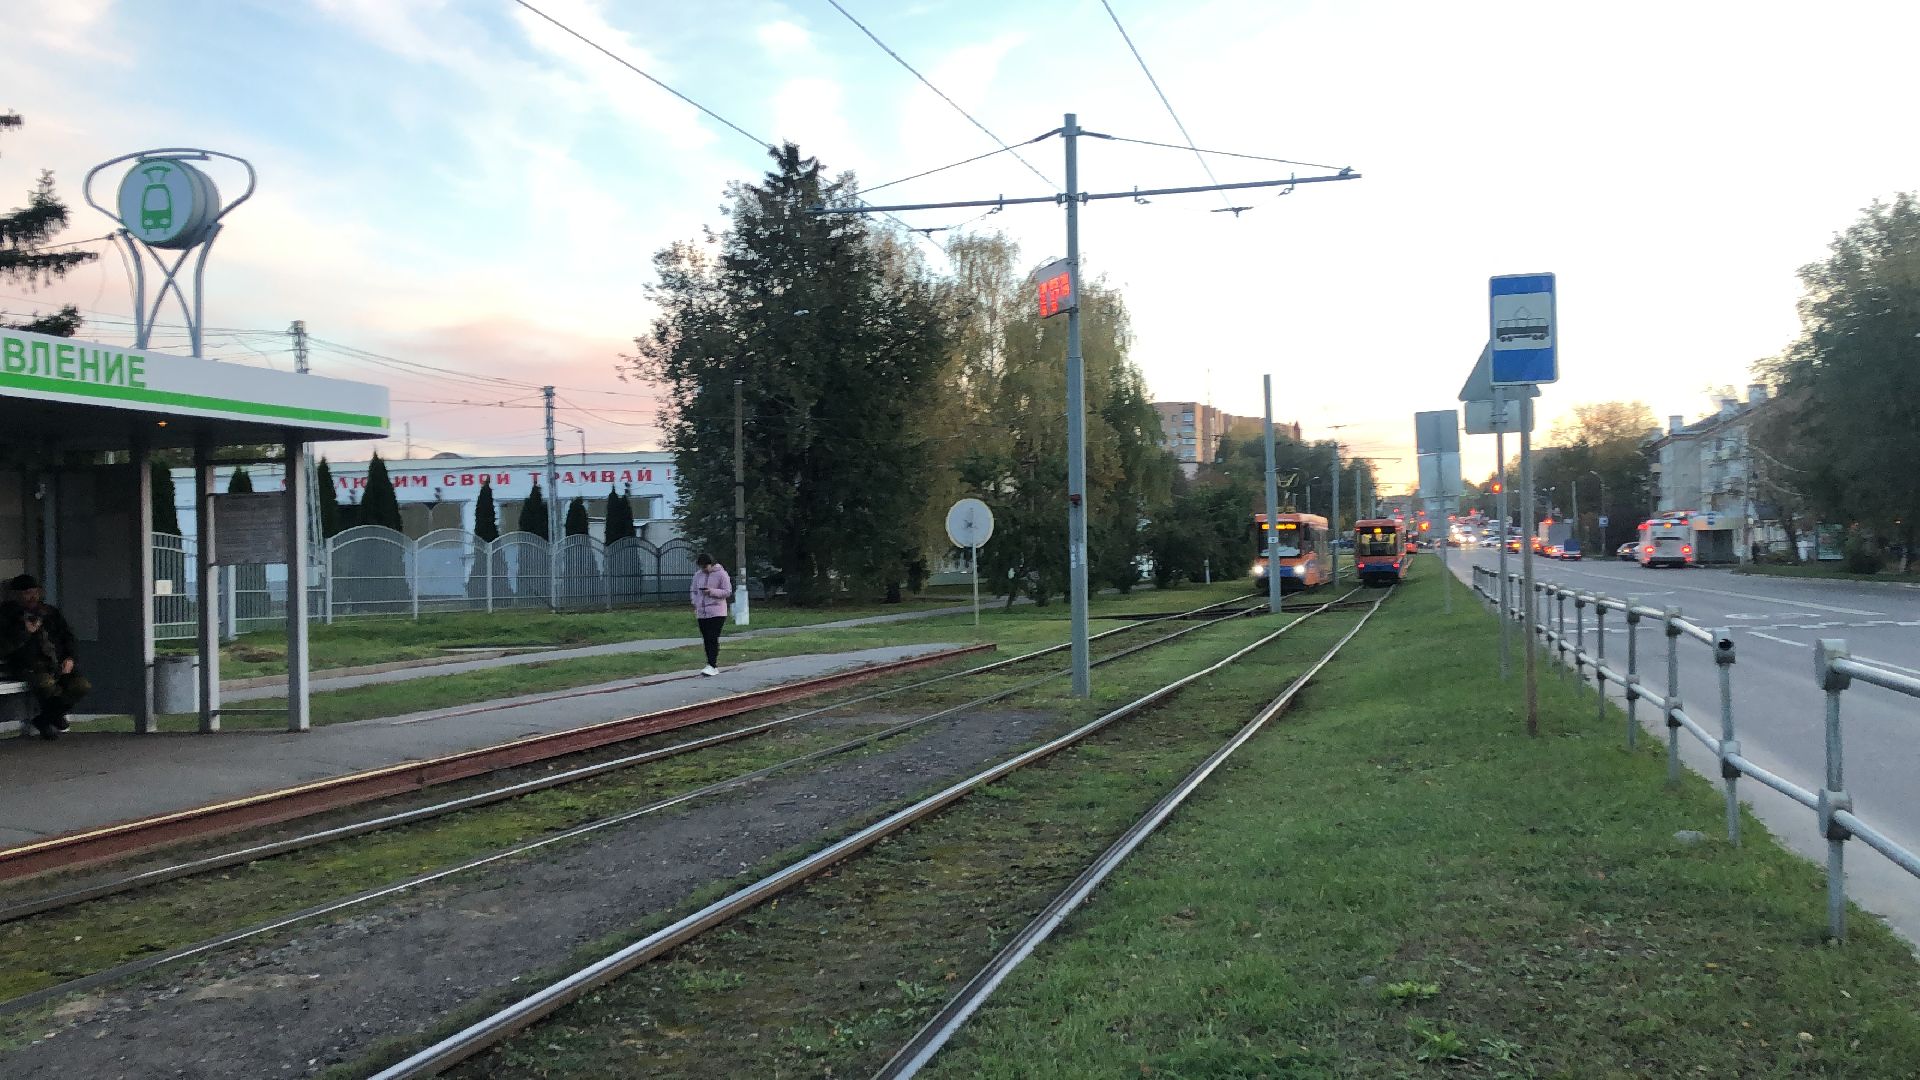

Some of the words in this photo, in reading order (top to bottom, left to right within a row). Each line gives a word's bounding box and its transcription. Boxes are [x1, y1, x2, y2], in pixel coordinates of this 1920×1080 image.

[3, 337, 146, 388] ВЛЕНИЕ
[335, 474, 428, 489] ЛЮИМ
[443, 471, 511, 487] СВОЙ
